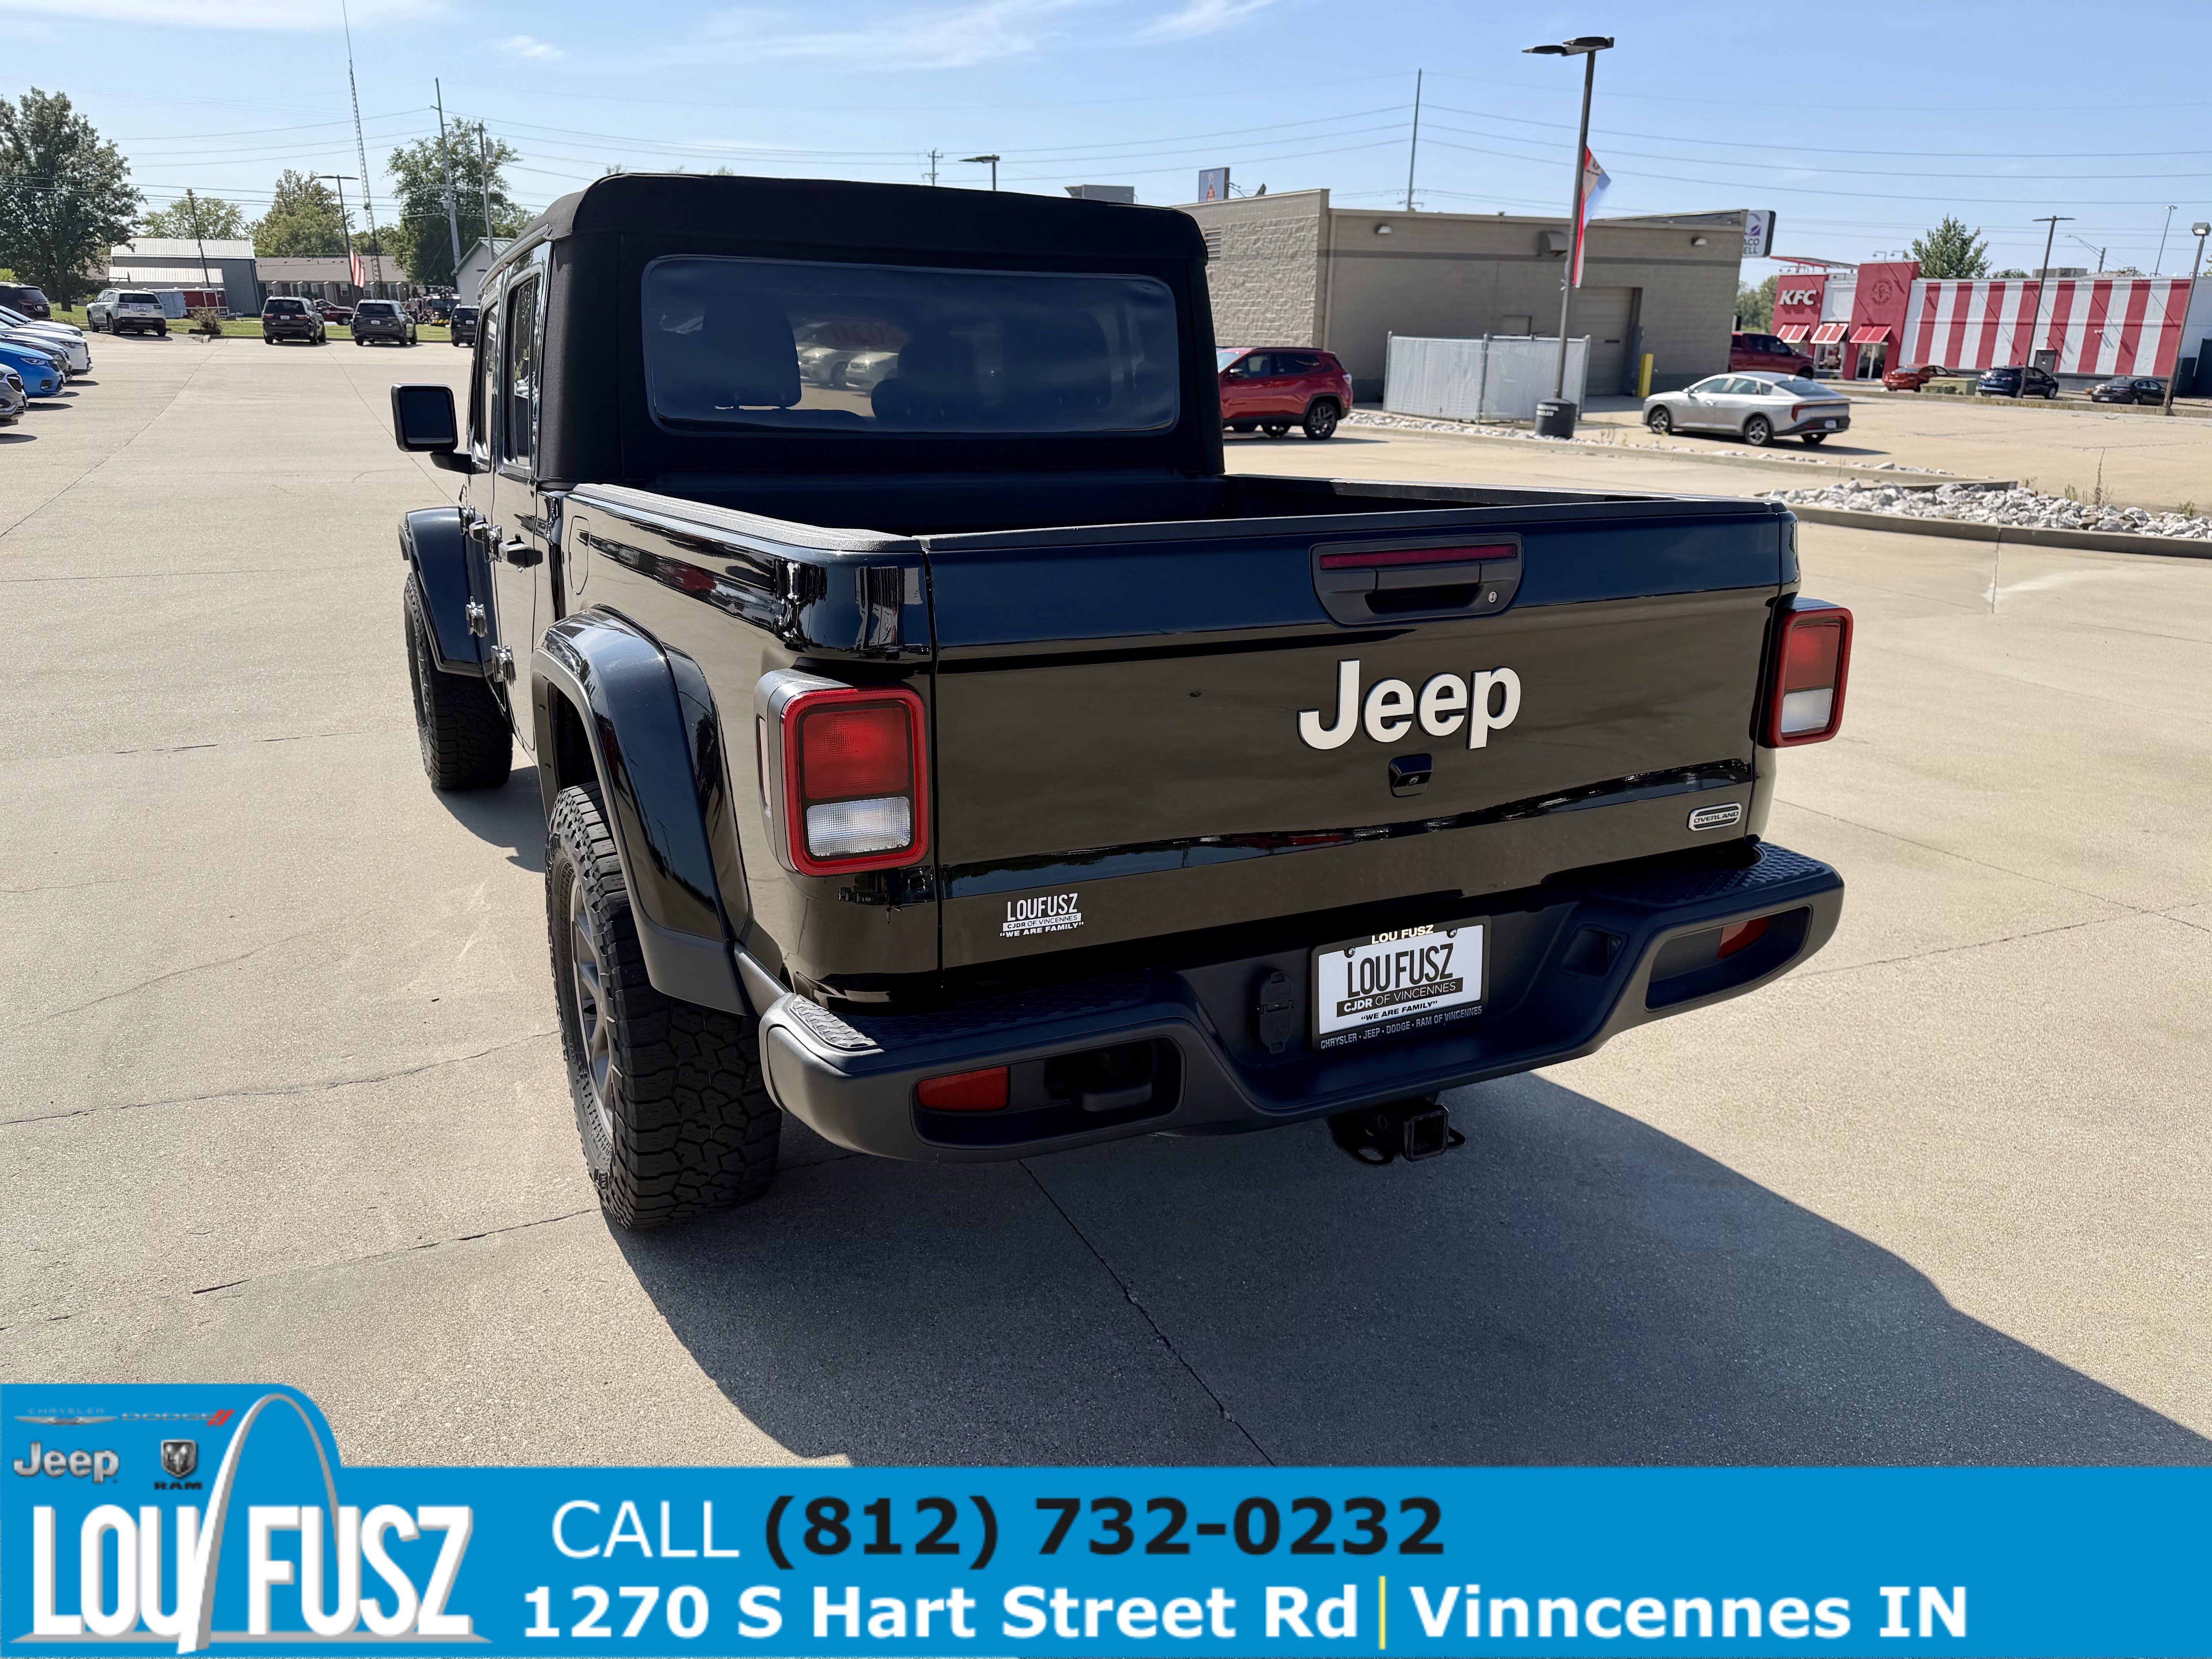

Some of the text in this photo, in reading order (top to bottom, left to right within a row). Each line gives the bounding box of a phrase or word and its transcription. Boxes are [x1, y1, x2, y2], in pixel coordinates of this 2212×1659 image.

[1778, 290, 1817, 305] KFC
[1298, 658, 1521, 750] Jeep
[1694, 811, 1739, 823] OVERLAND
[1039, 915, 1078, 925] VINCENNES
[1371, 924, 1434, 945] LOU FUSZ
[1348, 943, 1454, 998] LOU FUSZ
[1344, 981, 1456, 1013] CJDR OF VINCENNES
[1381, 1009, 1399, 1019] ARE
[1321, 1006, 1483, 1049] CHRYSLER JEEP DODGE RAM OF VINCENNES
